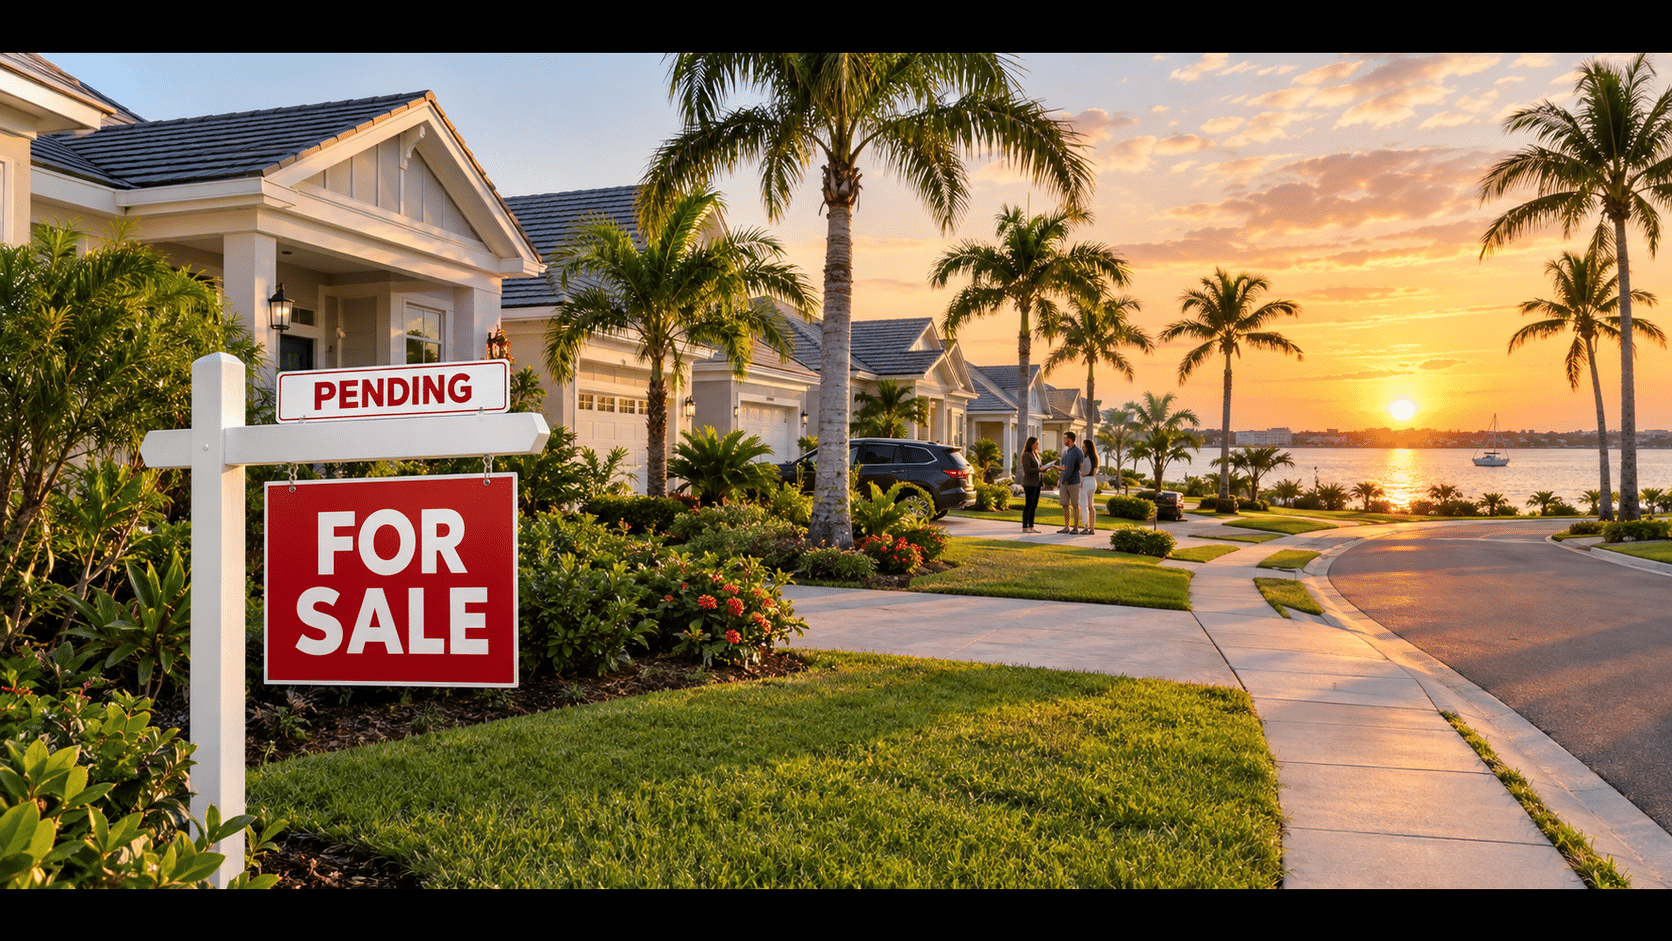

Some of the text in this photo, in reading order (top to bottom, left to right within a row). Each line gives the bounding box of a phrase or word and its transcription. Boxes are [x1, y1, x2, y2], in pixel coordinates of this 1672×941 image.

[314, 373, 472, 410] PENDING
[317, 508, 467, 576] FOR
[295, 586, 489, 656] SALE
